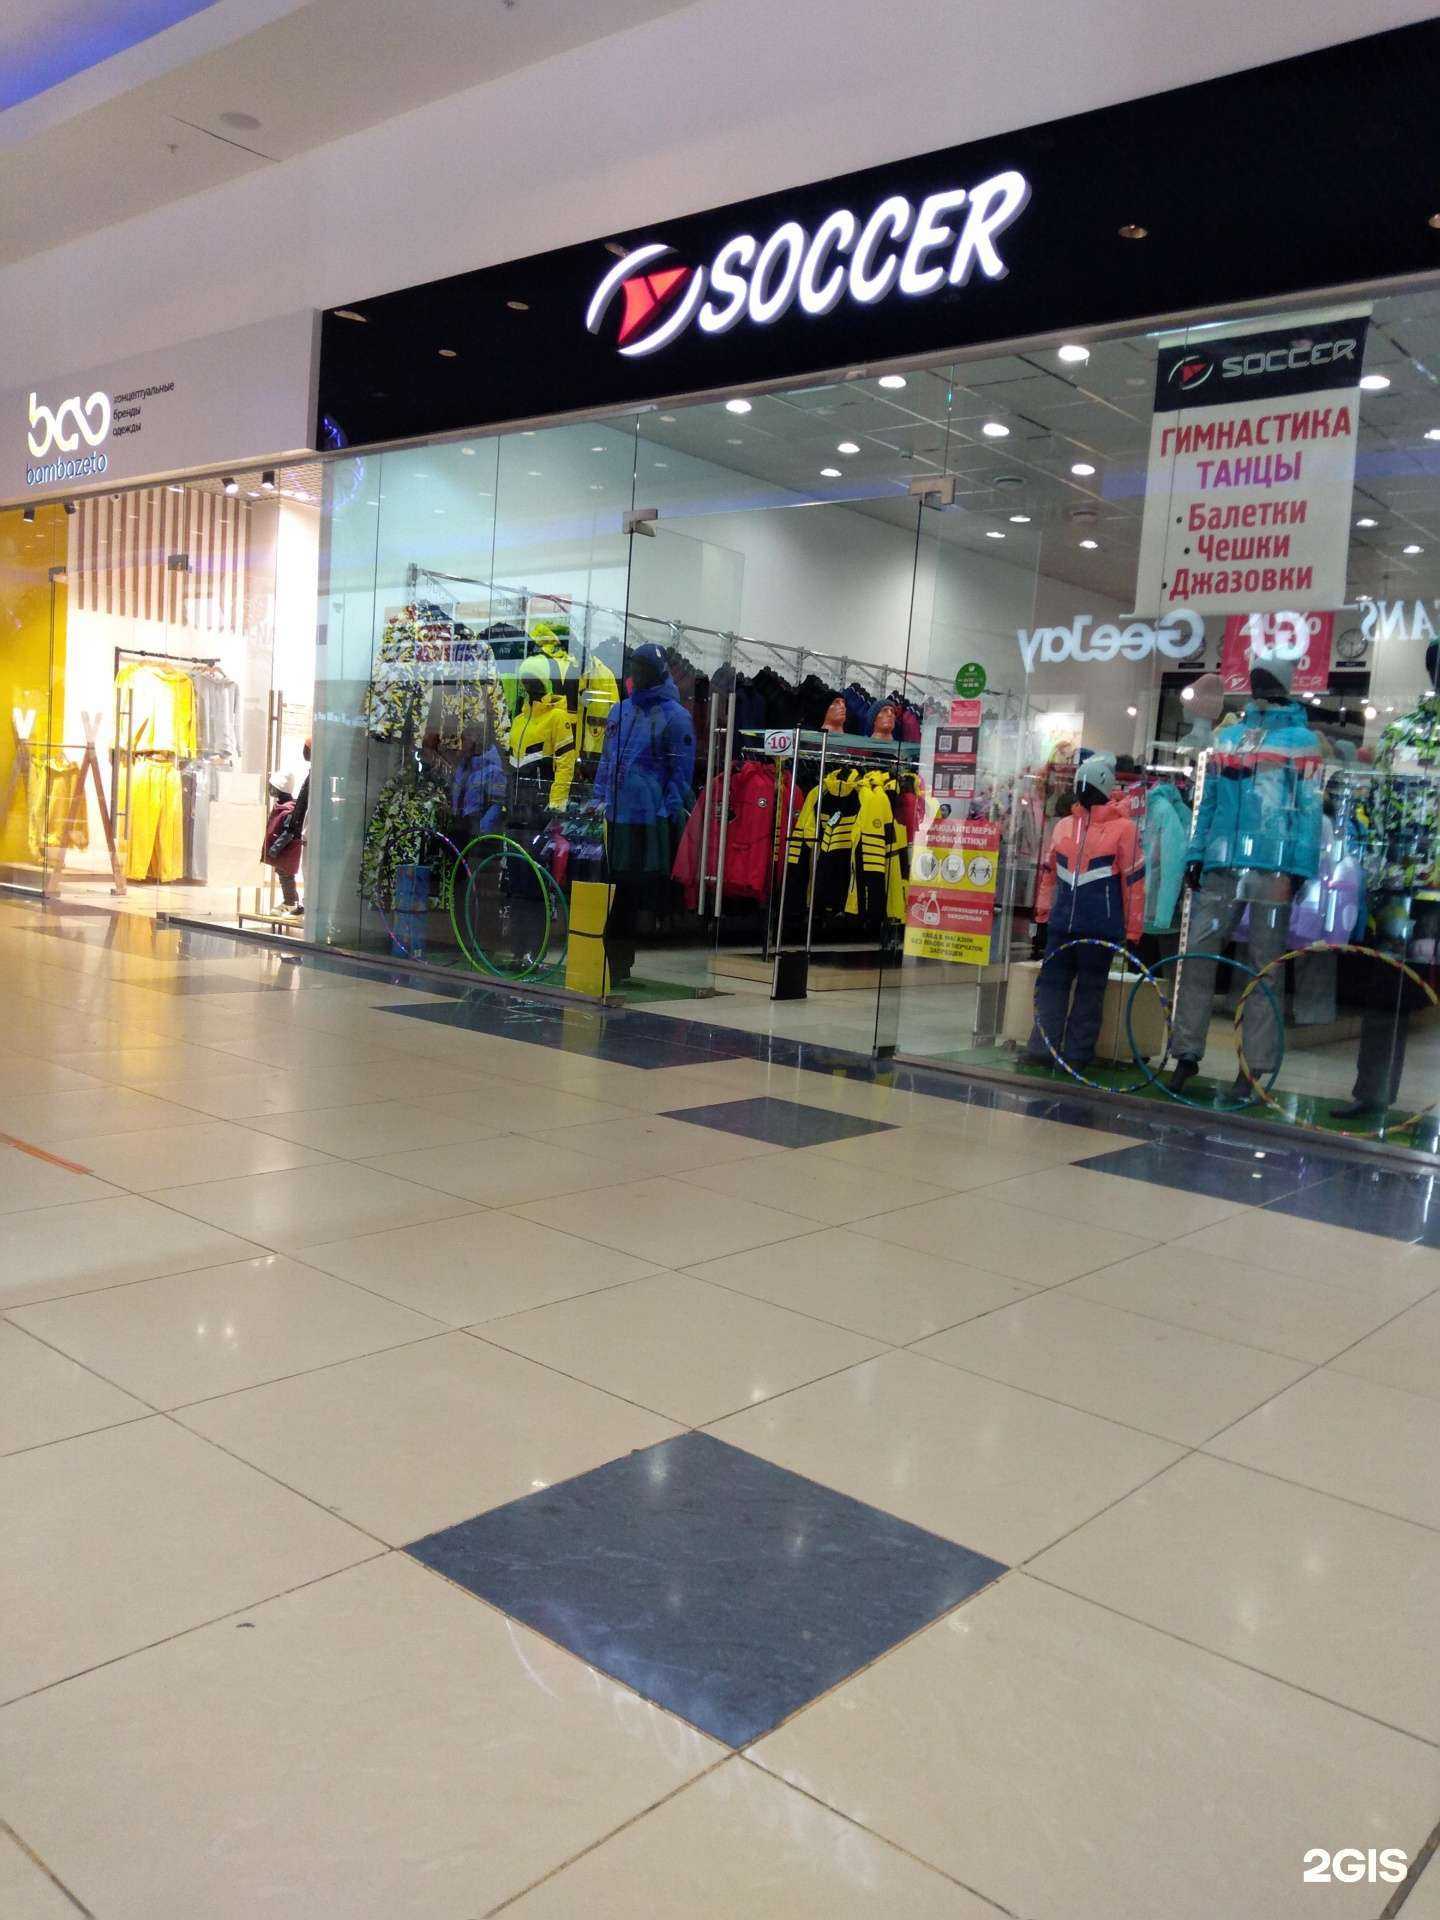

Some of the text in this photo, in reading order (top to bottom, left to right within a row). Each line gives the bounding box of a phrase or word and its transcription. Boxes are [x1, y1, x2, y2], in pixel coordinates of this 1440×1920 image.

[699, 171, 1031, 333] SOCCER
[1222, 339, 1357, 378] SOCCER
[113, 407, 142, 421] бренды
[113, 423, 142, 437] одежды
[1160, 407, 1351, 457] ГИМНАСТИКА
[27, 450, 108, 486] bambazeto
[1196, 451, 1303, 489] ТАНЦЫ
[1188, 500, 1308, 532] Балетки
[1197, 535, 1291, 562] Чешки
[1168, 566, 1313, 601] Джазовки
